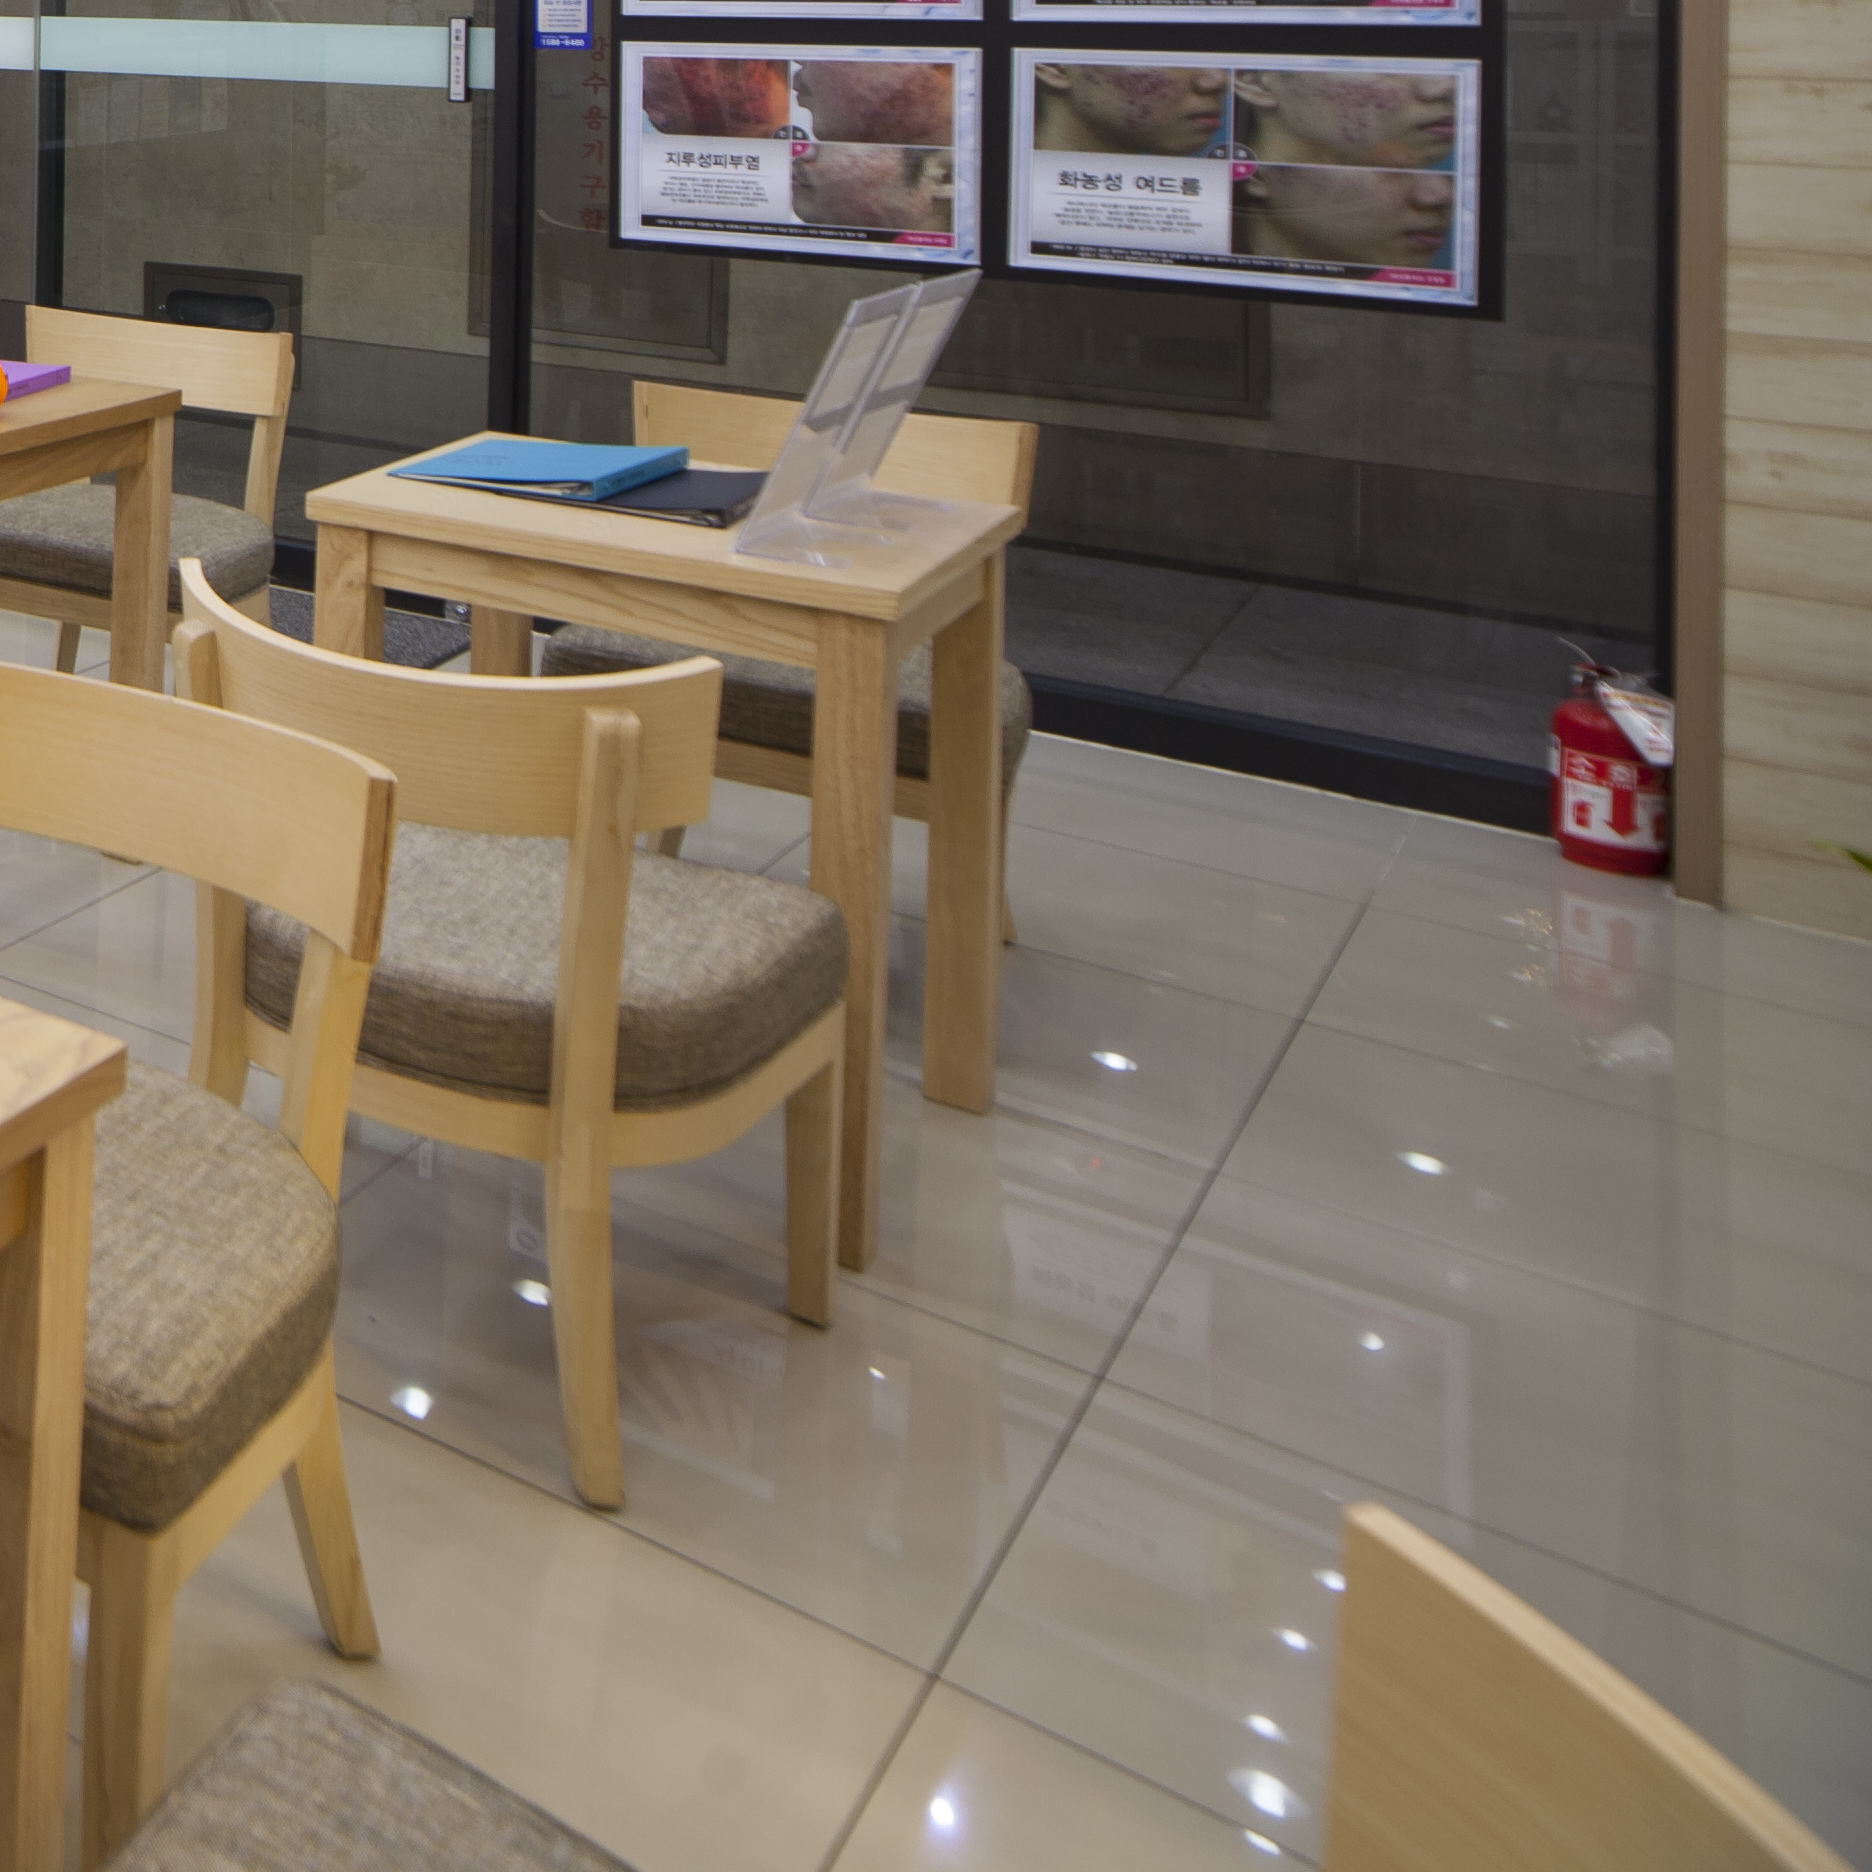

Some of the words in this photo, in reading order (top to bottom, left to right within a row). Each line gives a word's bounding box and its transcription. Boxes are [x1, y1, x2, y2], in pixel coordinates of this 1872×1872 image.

[664, 151, 762, 171] 지루성피부염
[1057, 169, 1124, 192] 화농성
[1134, 173, 1204, 198] 여드름
